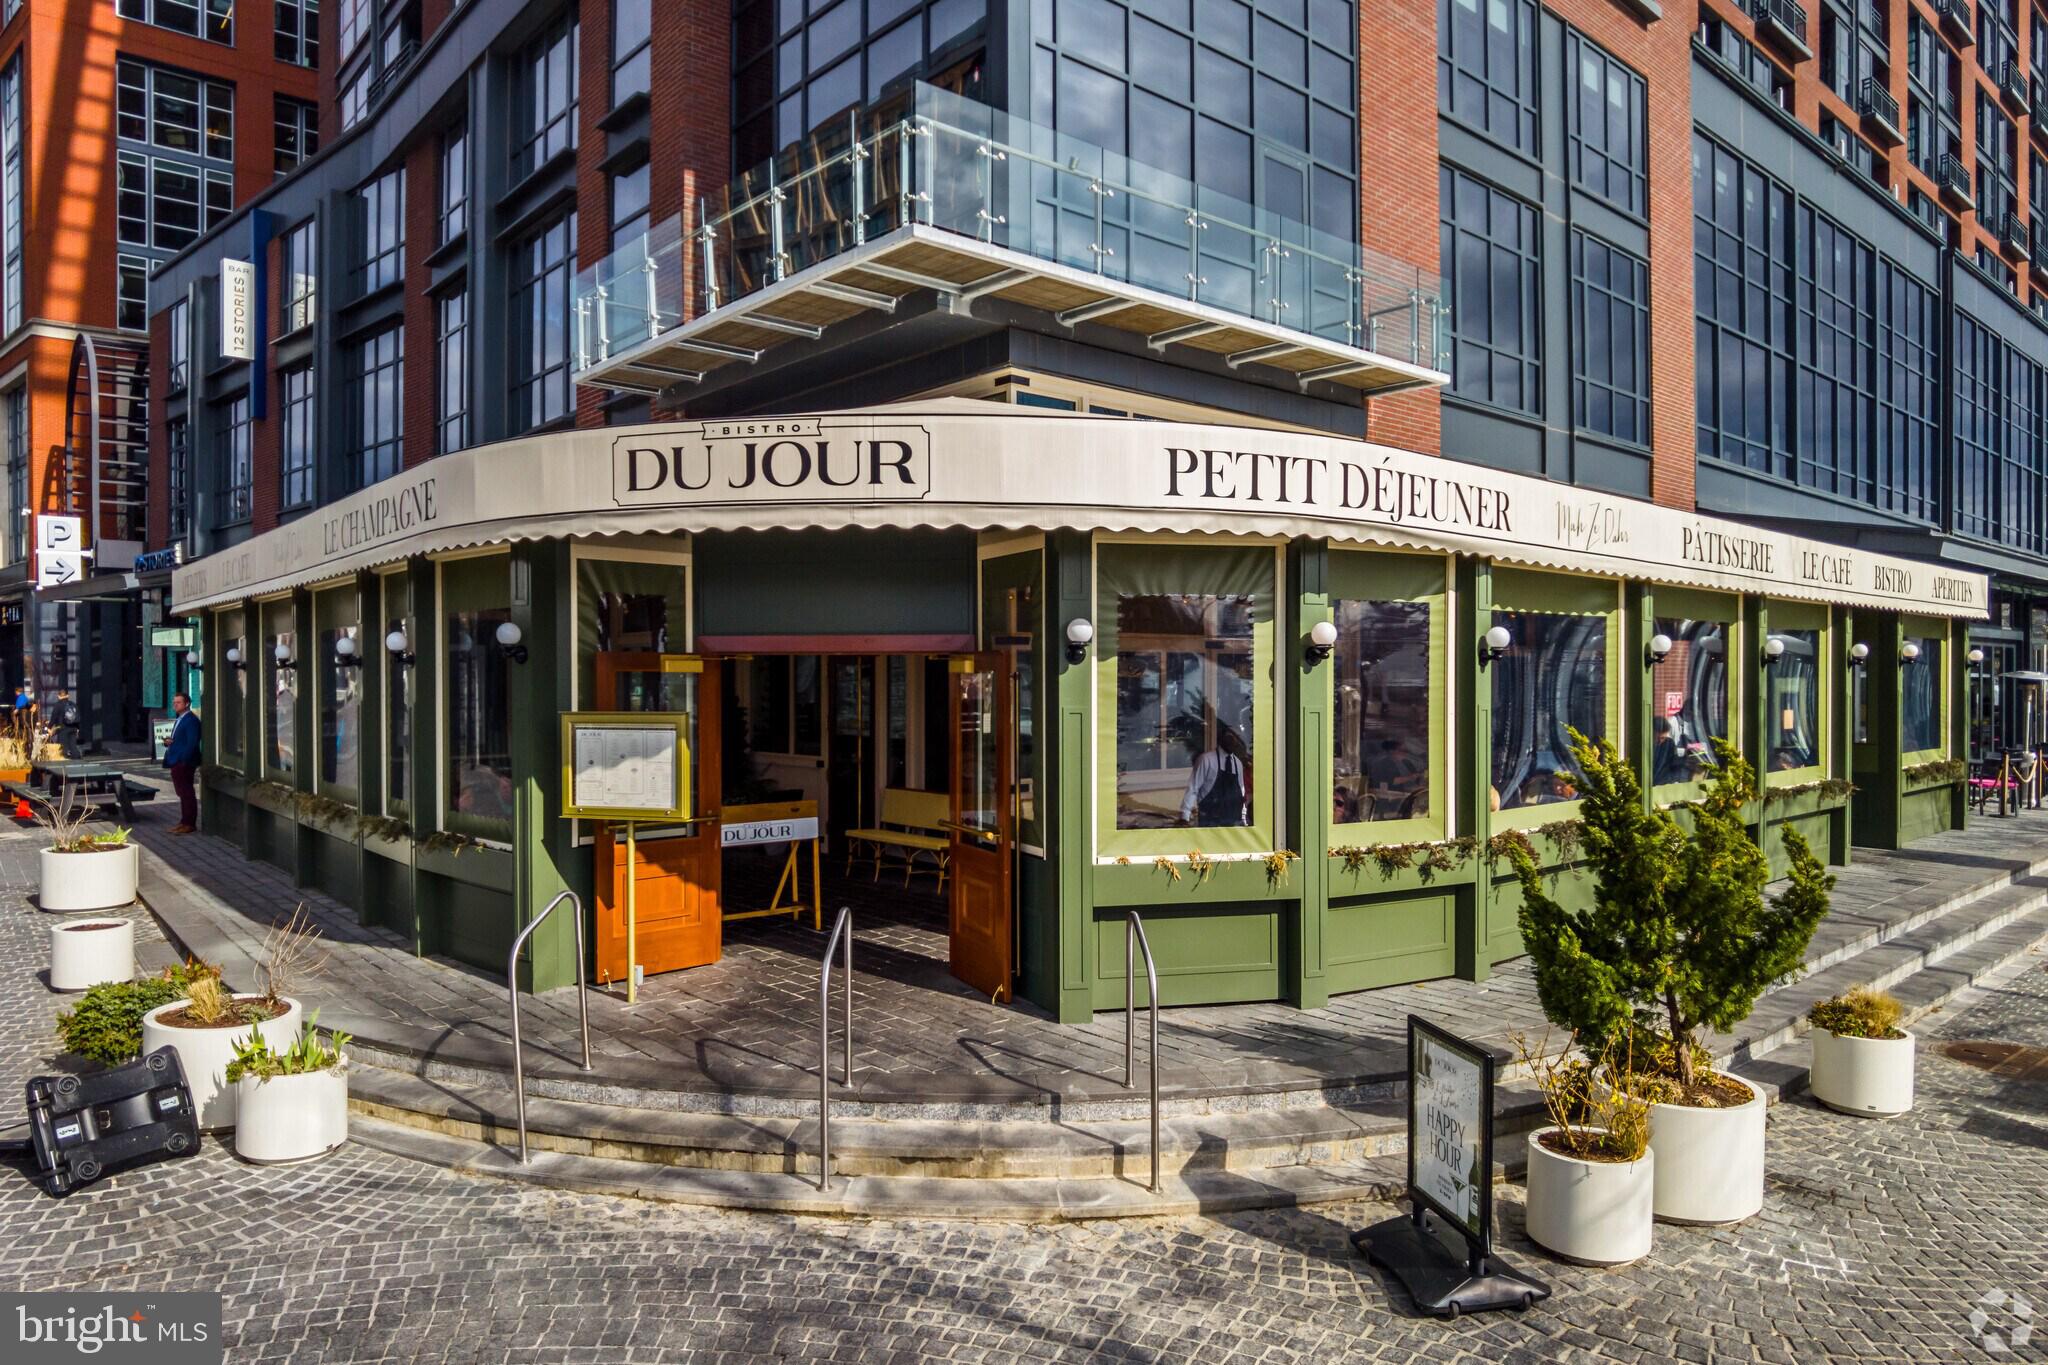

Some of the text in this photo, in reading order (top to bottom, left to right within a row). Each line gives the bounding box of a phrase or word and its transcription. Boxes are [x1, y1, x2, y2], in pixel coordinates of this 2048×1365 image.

[228, 265, 250, 276] BAR
[722, 424, 801, 435] BISTRO
[627, 441, 916, 492] DU JOUR
[1163, 447, 1512, 532] PETIT DÉJEUNER
[323, 518, 339, 555] LE
[341, 478, 438, 550] CHAMPAGNE
[47, 520, 72, 548] P
[1682, 521, 1774, 573] PÂTISSERIE
[1802, 551, 1853, 585] LE CAFÉ
[1874, 565, 1912, 594] BISTRO
[1932, 572, 1973, 604] APÉRITIFS
[724, 825, 791, 842] DU JOUR
[1426, 1103, 1466, 1148] HAPPY
[1430, 1130, 1462, 1175] HOUR
